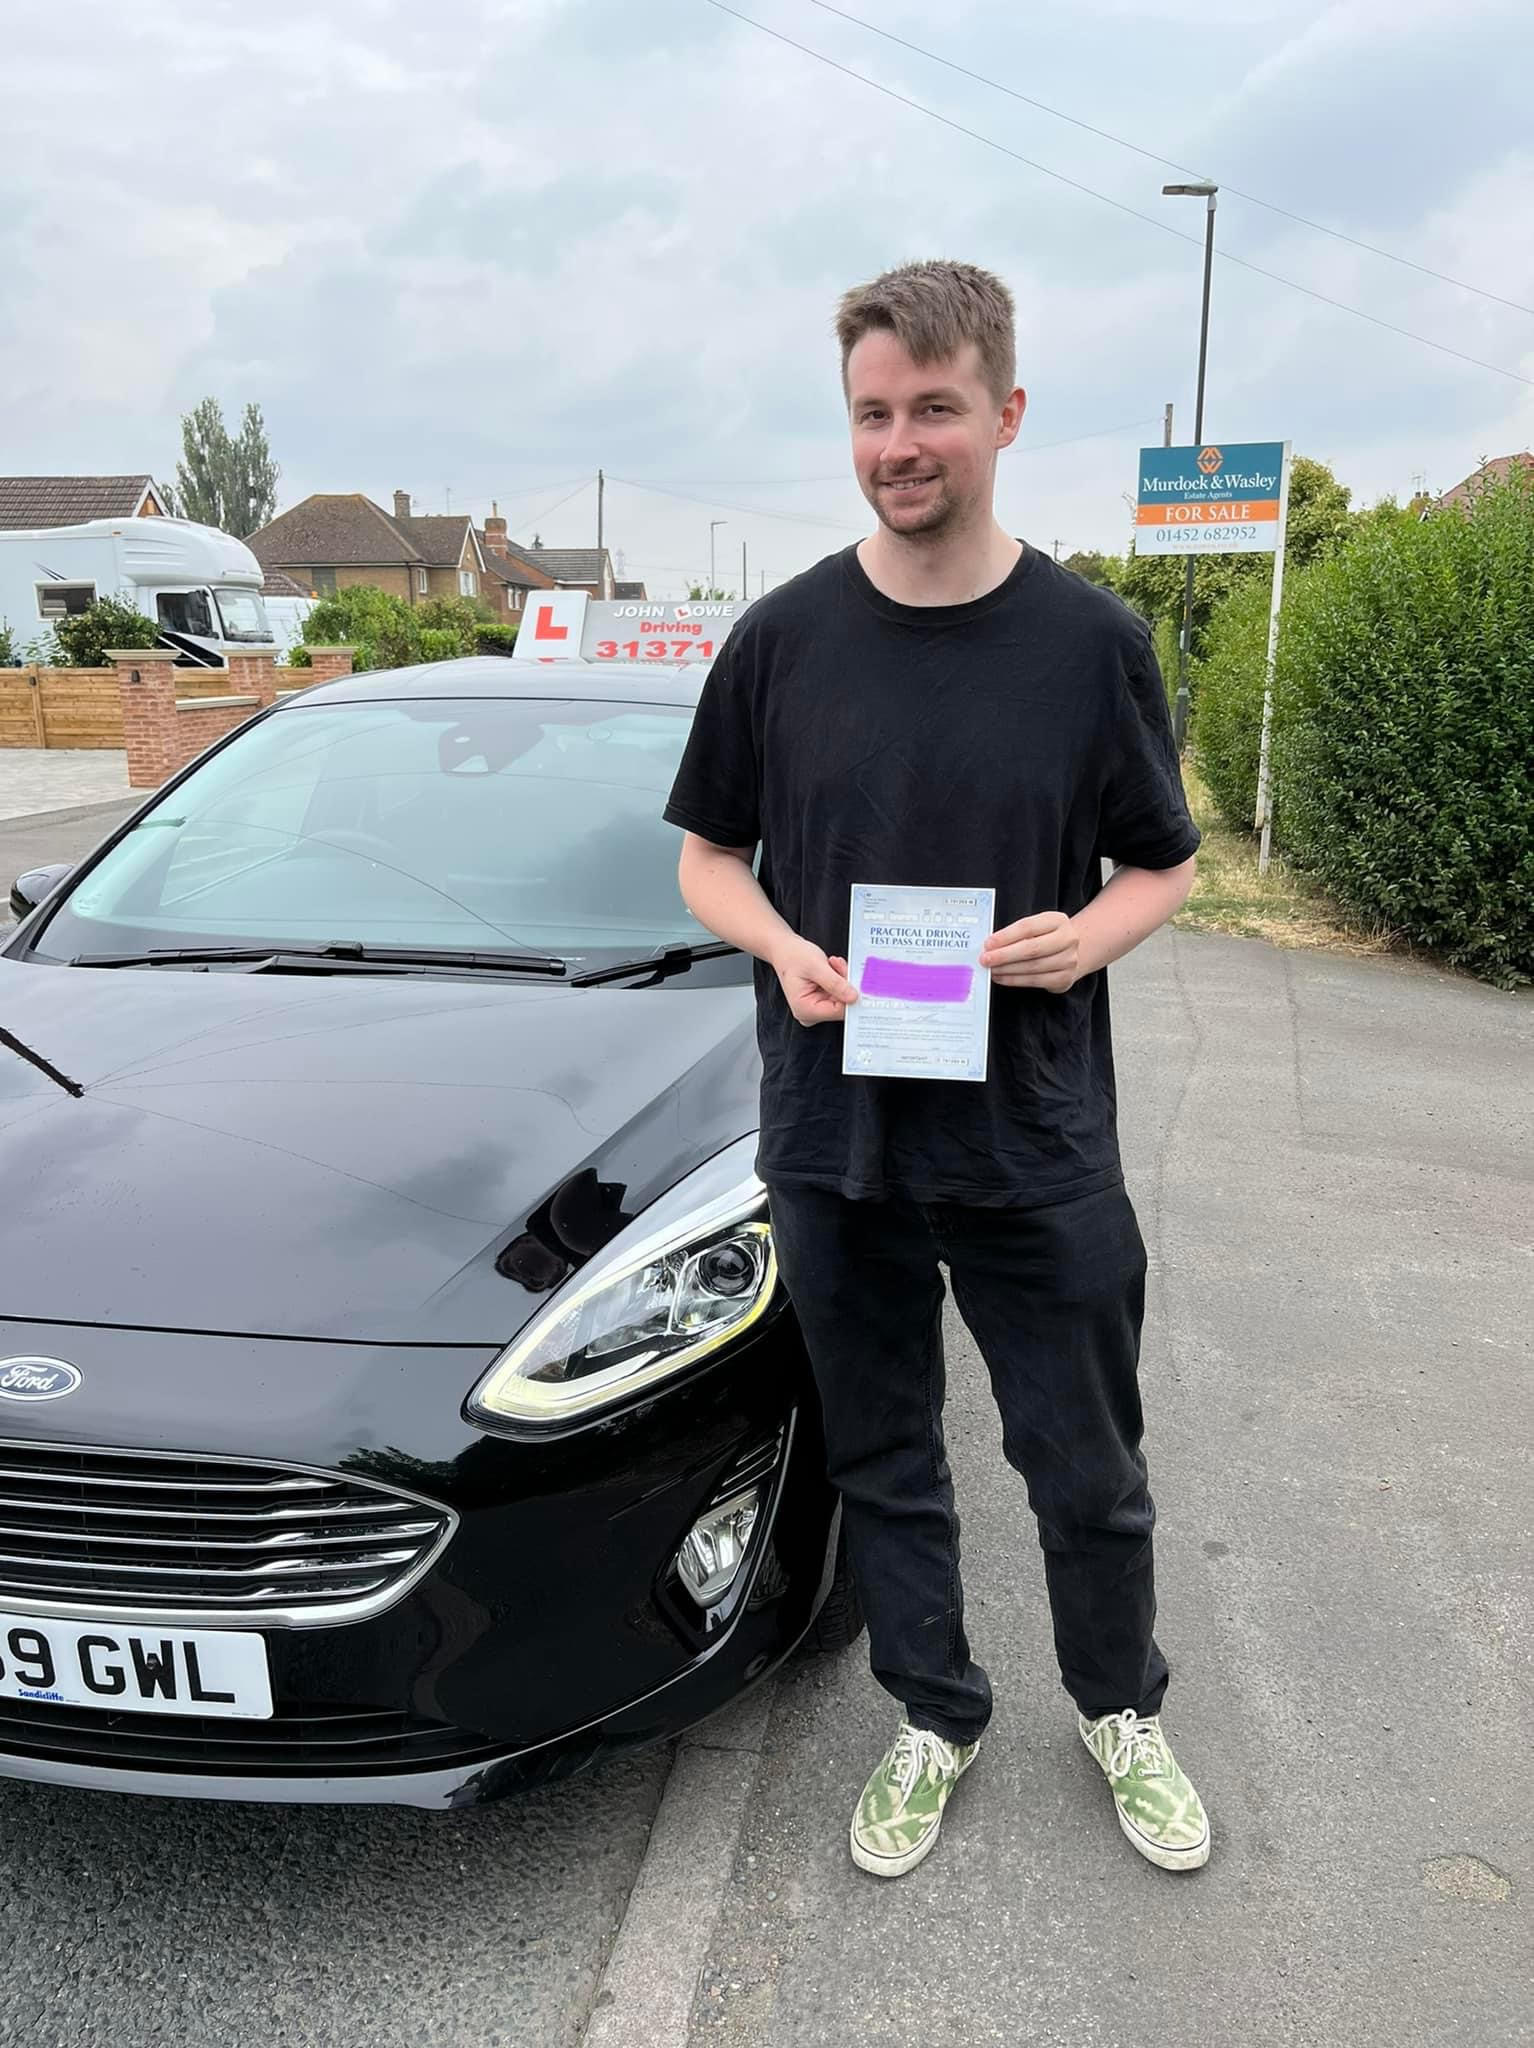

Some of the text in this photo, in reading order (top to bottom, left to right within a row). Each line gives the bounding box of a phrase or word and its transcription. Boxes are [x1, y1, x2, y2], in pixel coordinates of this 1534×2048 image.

[1143, 472, 1277, 492] Murdock & Wasley
[1184, 491, 1232, 500] Estate Agents
[1165, 504, 1250, 522] FOR SALE
[1156, 526, 1257, 542] 01452 682952
[614, 604, 735, 619] JOHN LOWE
[534, 606, 568, 640] L
[640, 621, 703, 636] Driving
[595, 640, 724, 658] 31371
[870, 927, 970, 939] PRACTICAL DRIVING
[871, 936, 969, 948] TEST PASS CERTIFICATE
[0, 1364, 59, 1390] Ford
[0, 1627, 236, 1704] 9 GWL
